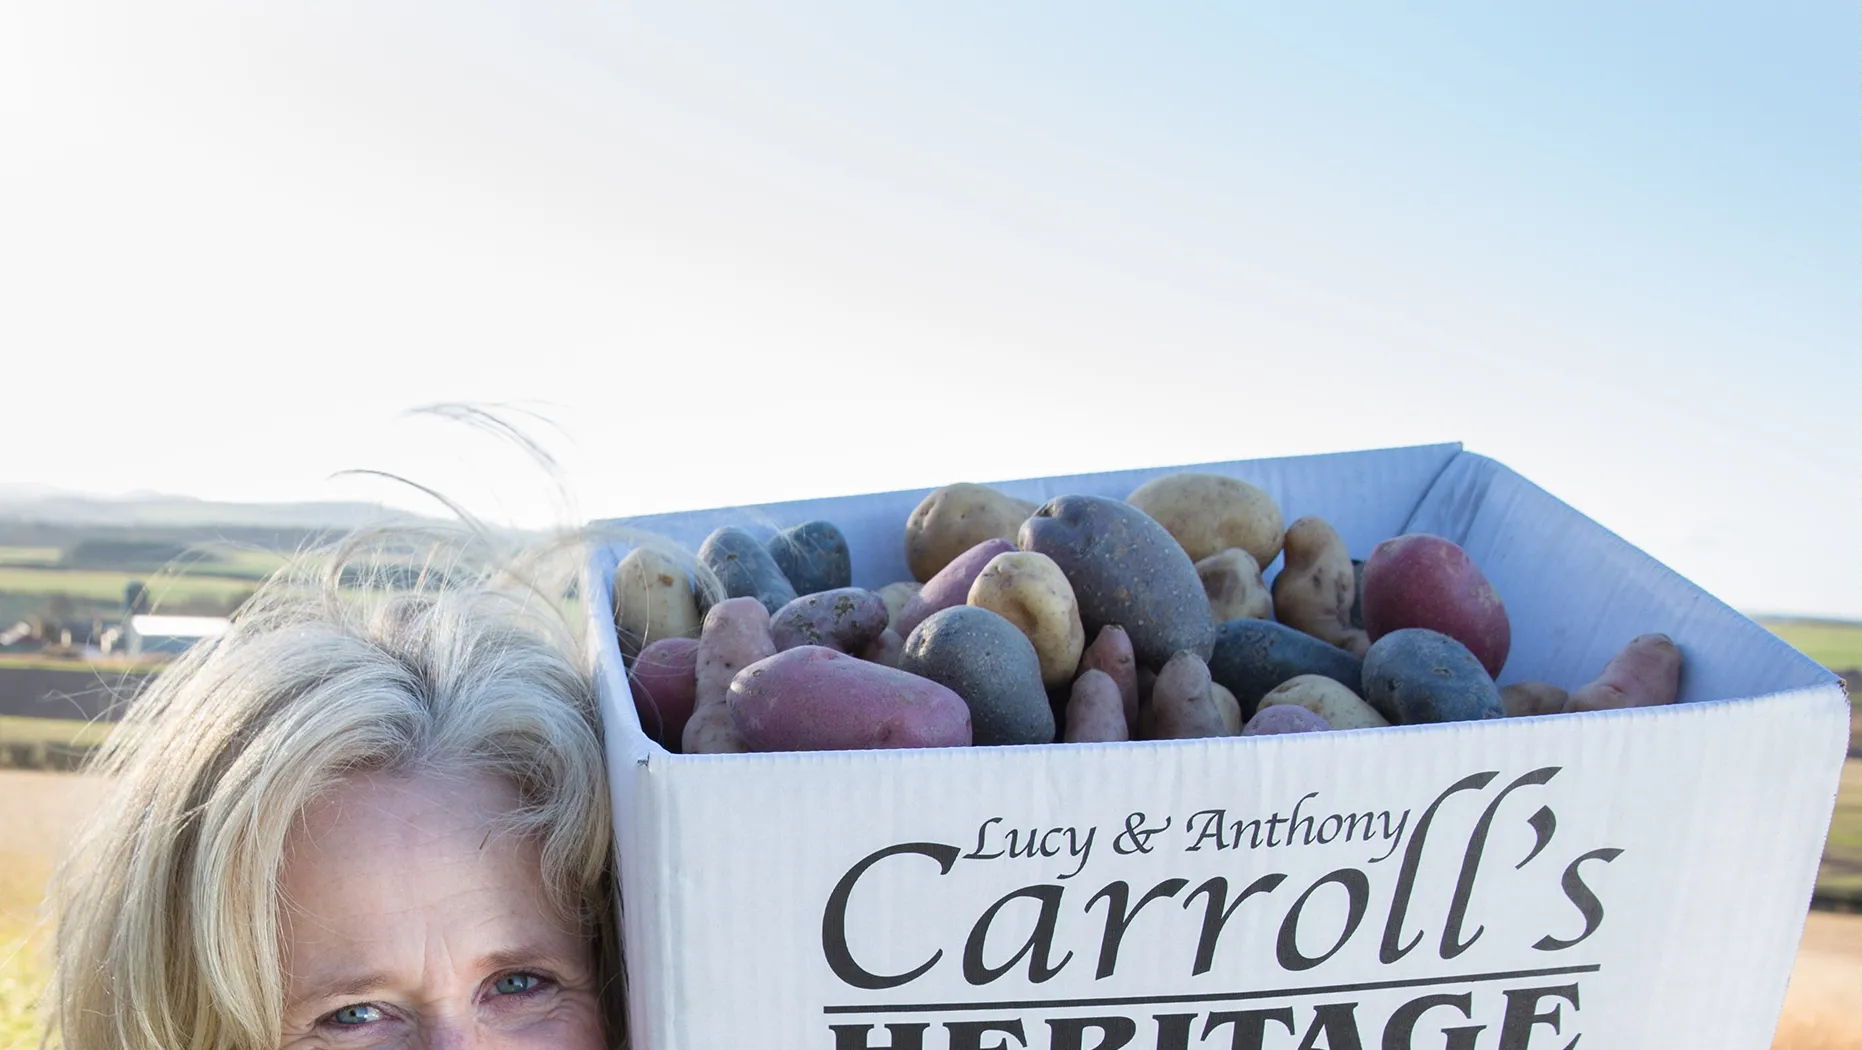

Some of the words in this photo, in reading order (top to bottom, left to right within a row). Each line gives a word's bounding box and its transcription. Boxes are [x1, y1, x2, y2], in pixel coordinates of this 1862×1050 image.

[821, 766, 1625, 990] Carroll's
[965, 817, 1097, 879] Lucy
[1112, 812, 1172, 855] &
[1184, 791, 1411, 864] Anthony
